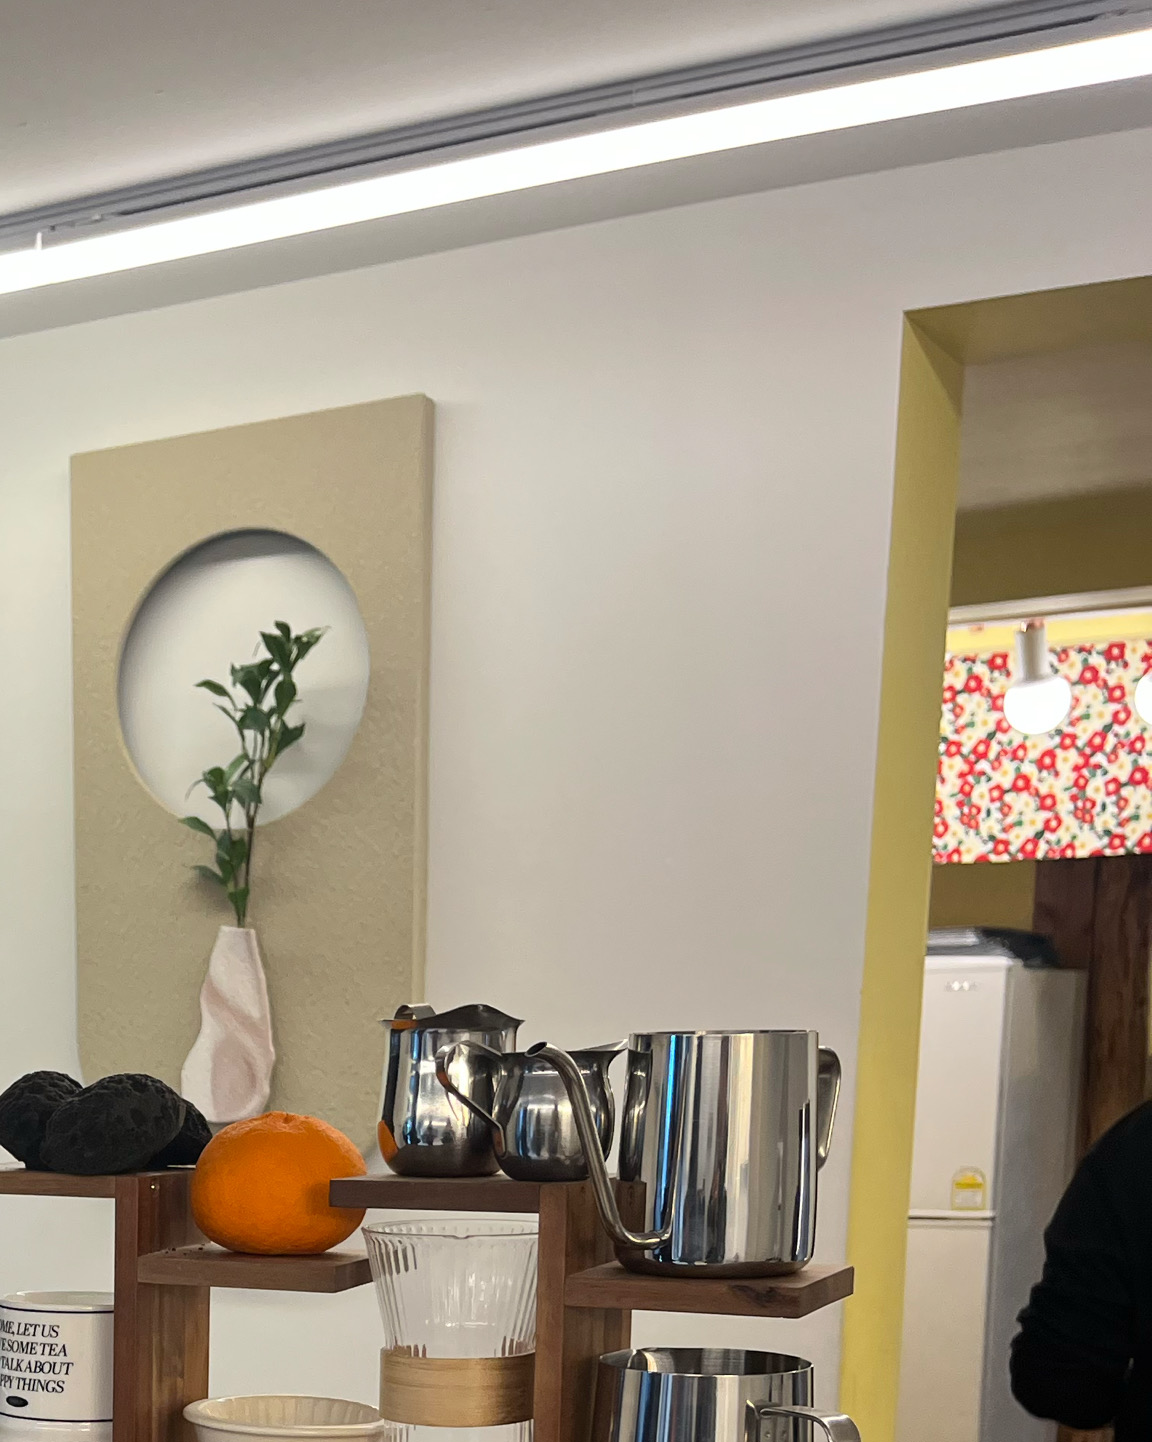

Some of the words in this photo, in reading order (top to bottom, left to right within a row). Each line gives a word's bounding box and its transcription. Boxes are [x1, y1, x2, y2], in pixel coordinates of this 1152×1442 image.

[16, 1322, 41, 1337] LET
[41, 1323, 60, 1338] US
[7, 1339, 39, 1355] SOME
[39, 1342, 68, 1357] TEA
[1, 1356, 24, 1372] TALK
[23, 1360, 74, 1376] ABOUT
[15, 1376, 65, 1393] THINGS
